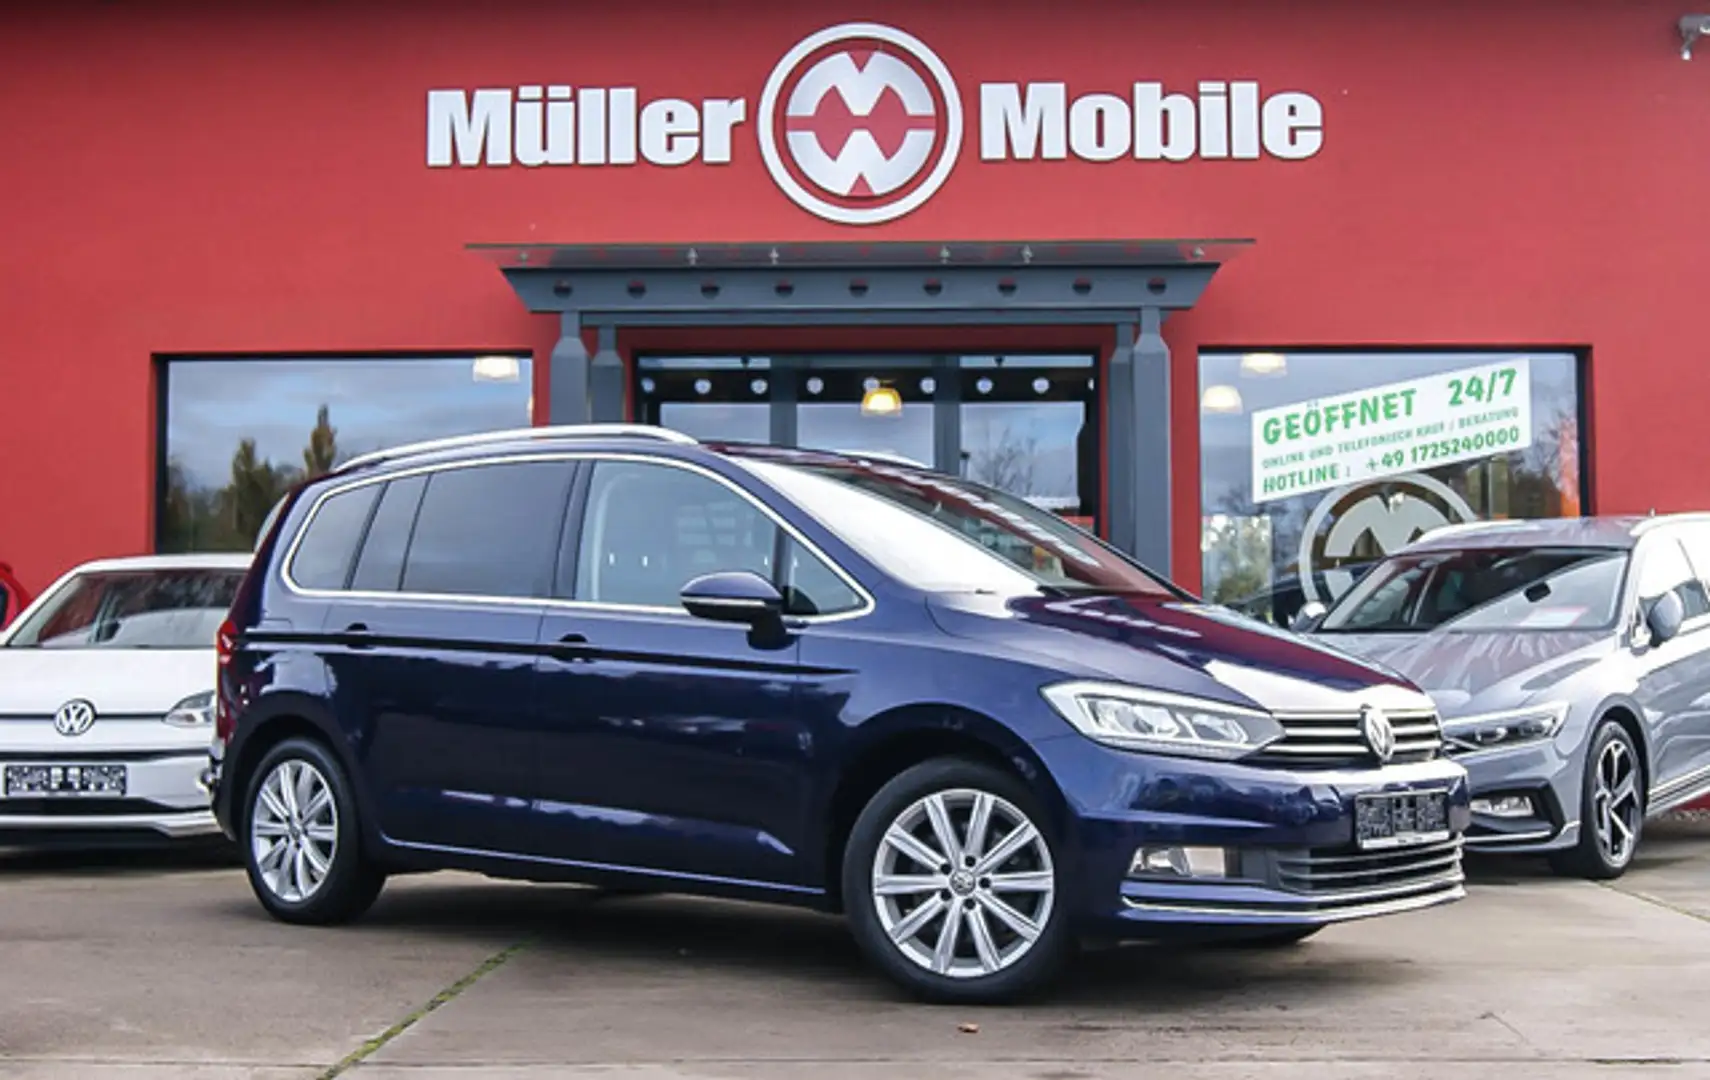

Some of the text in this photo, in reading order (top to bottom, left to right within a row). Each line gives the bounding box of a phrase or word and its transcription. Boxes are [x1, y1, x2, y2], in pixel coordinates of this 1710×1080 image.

[427, 82, 1323, 167] Müller Mobile
[1262, 451, 1304, 469] ONLINE
[1309, 445, 1333, 460] UND
[1459, 406, 1519, 428] BERATUNG
[1263, 368, 1517, 445] GEÖFFNET 24/7
[1264, 462, 1339, 494] HOTLINE
[1411, 425, 1519, 463] 1725240000
